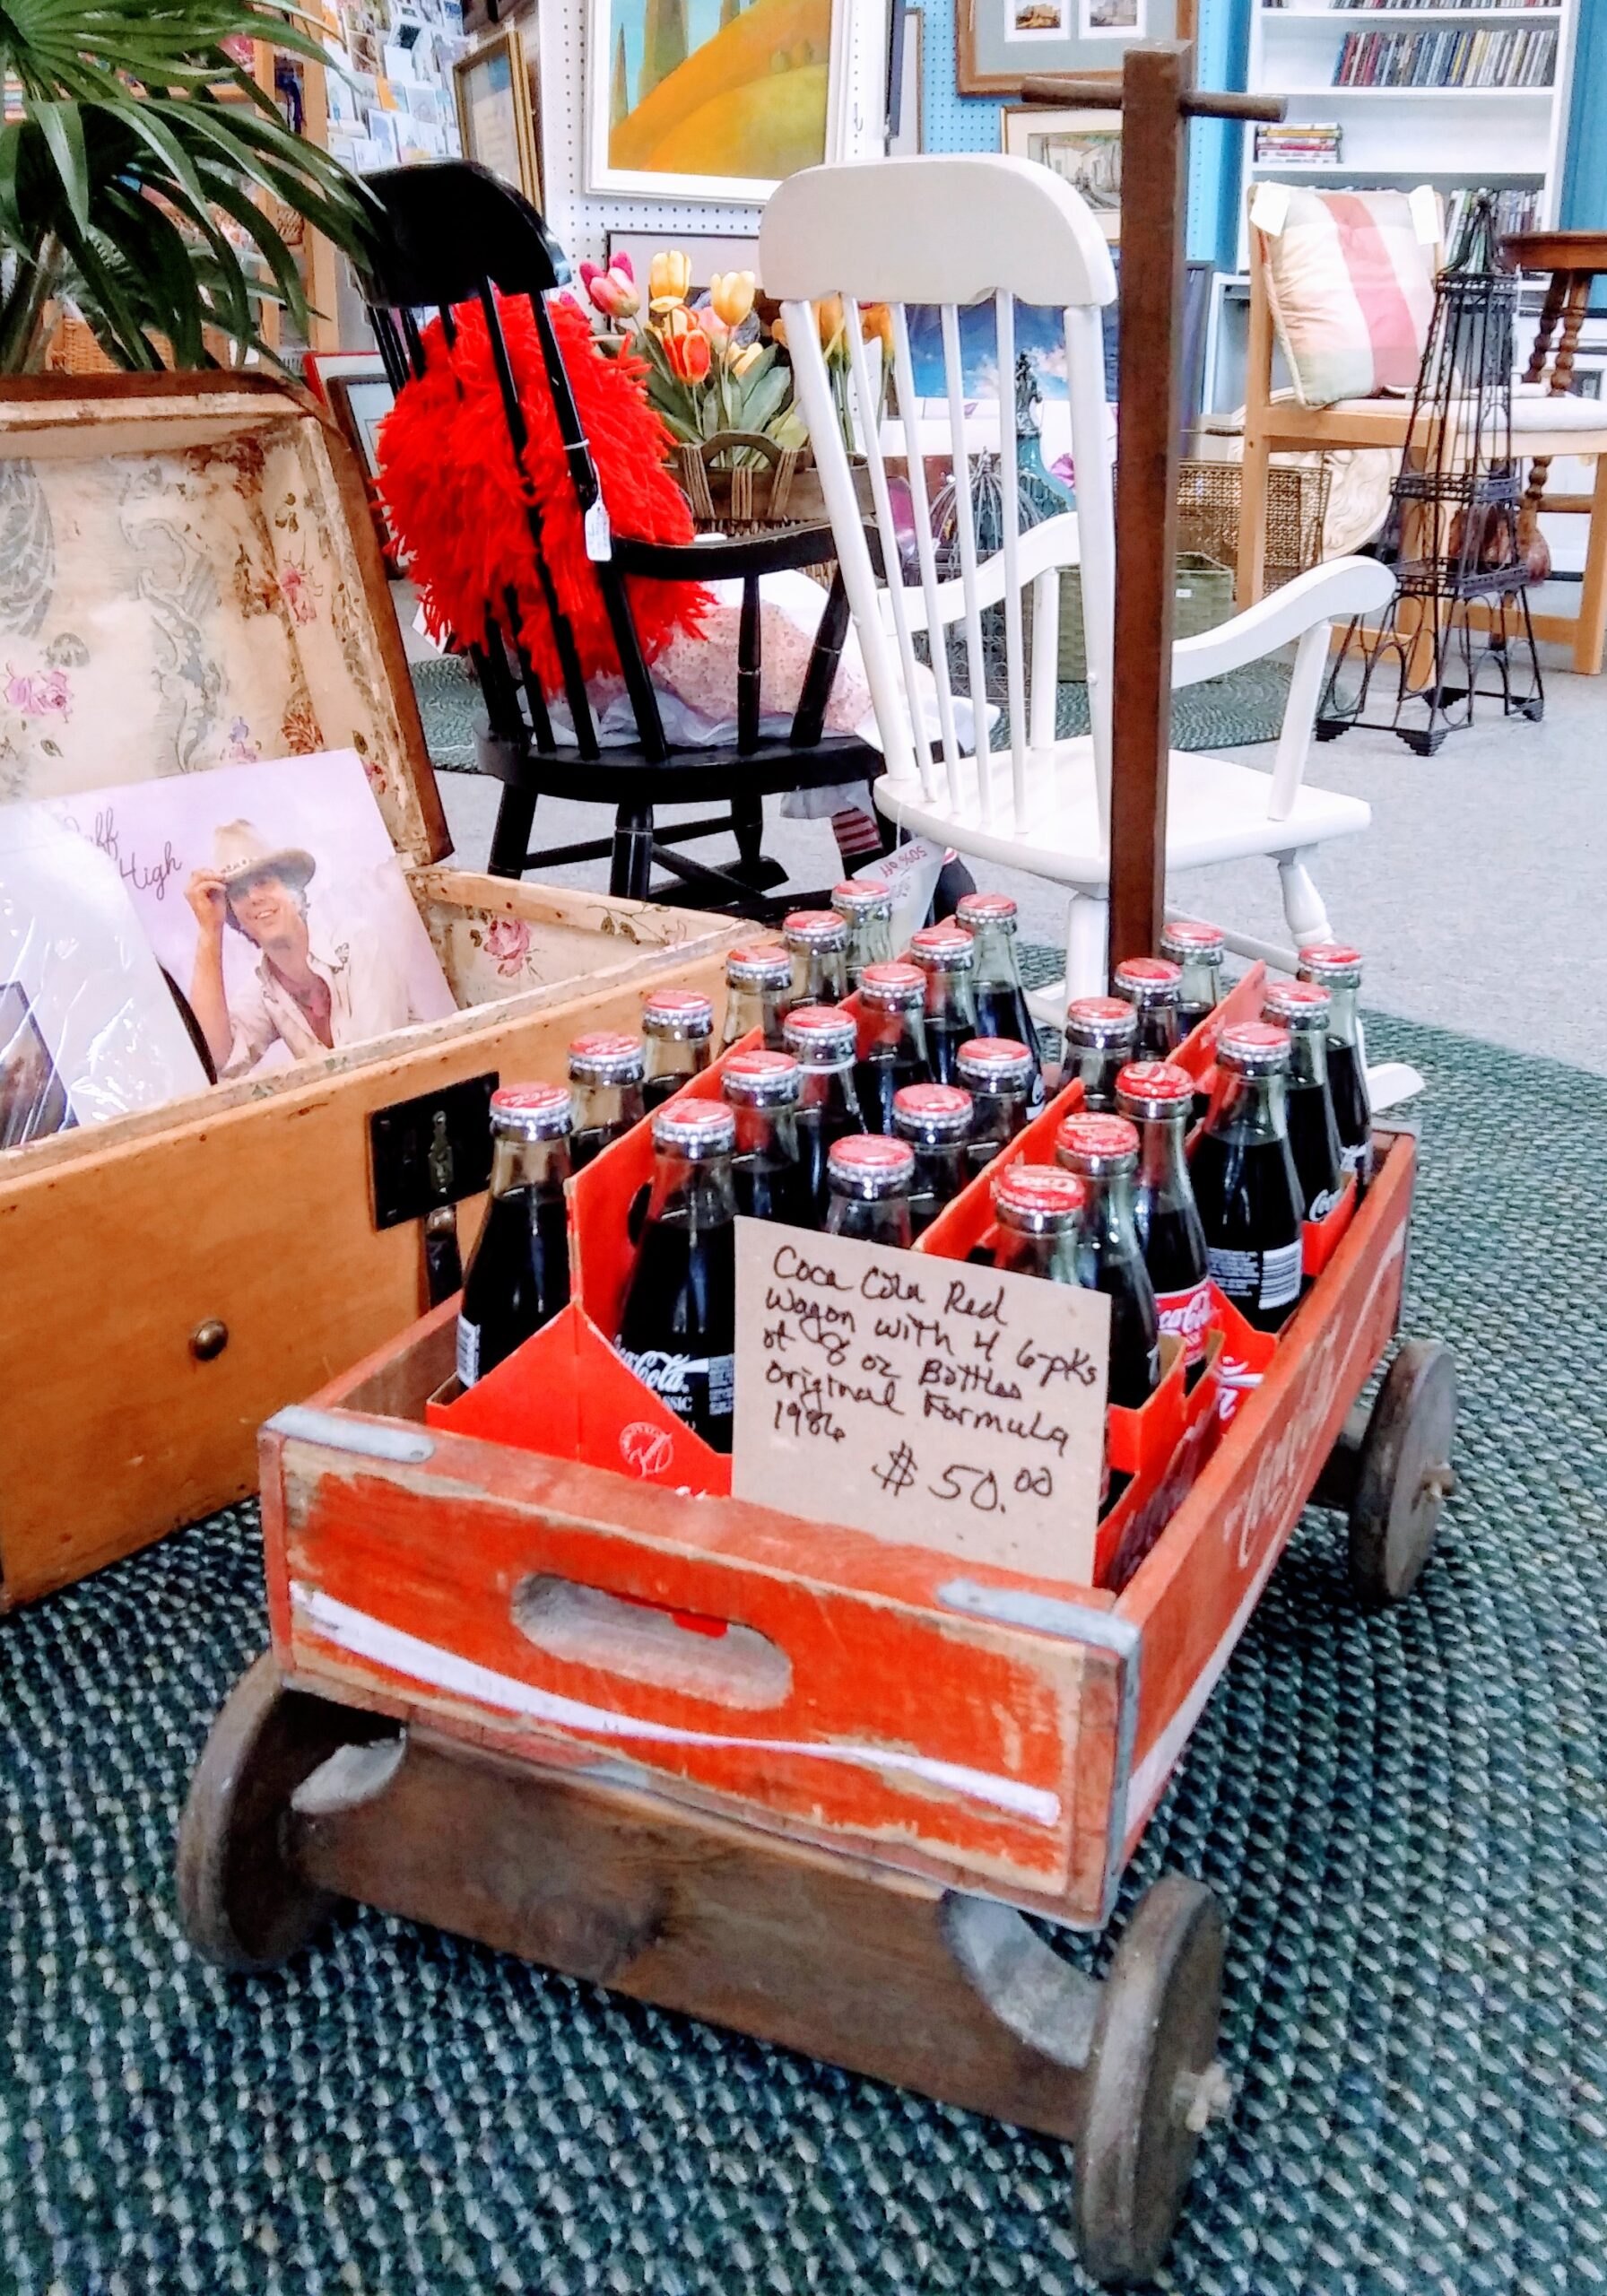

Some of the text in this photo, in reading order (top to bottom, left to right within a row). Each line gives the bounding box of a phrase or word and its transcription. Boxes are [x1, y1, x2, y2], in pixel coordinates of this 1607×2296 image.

[119, 840, 182, 901] High
[879, 861, 899, 878] off
[774, 1245, 1008, 1326] Coca Cola Red
[763, 1319, 1023, 1401] of 8 oz Bottles
[875, 1313, 954, 1356] with
[974, 1329, 993, 1362] 4
[773, 1400, 847, 1443] 1986
[923, 1391, 1070, 1457] Formula
